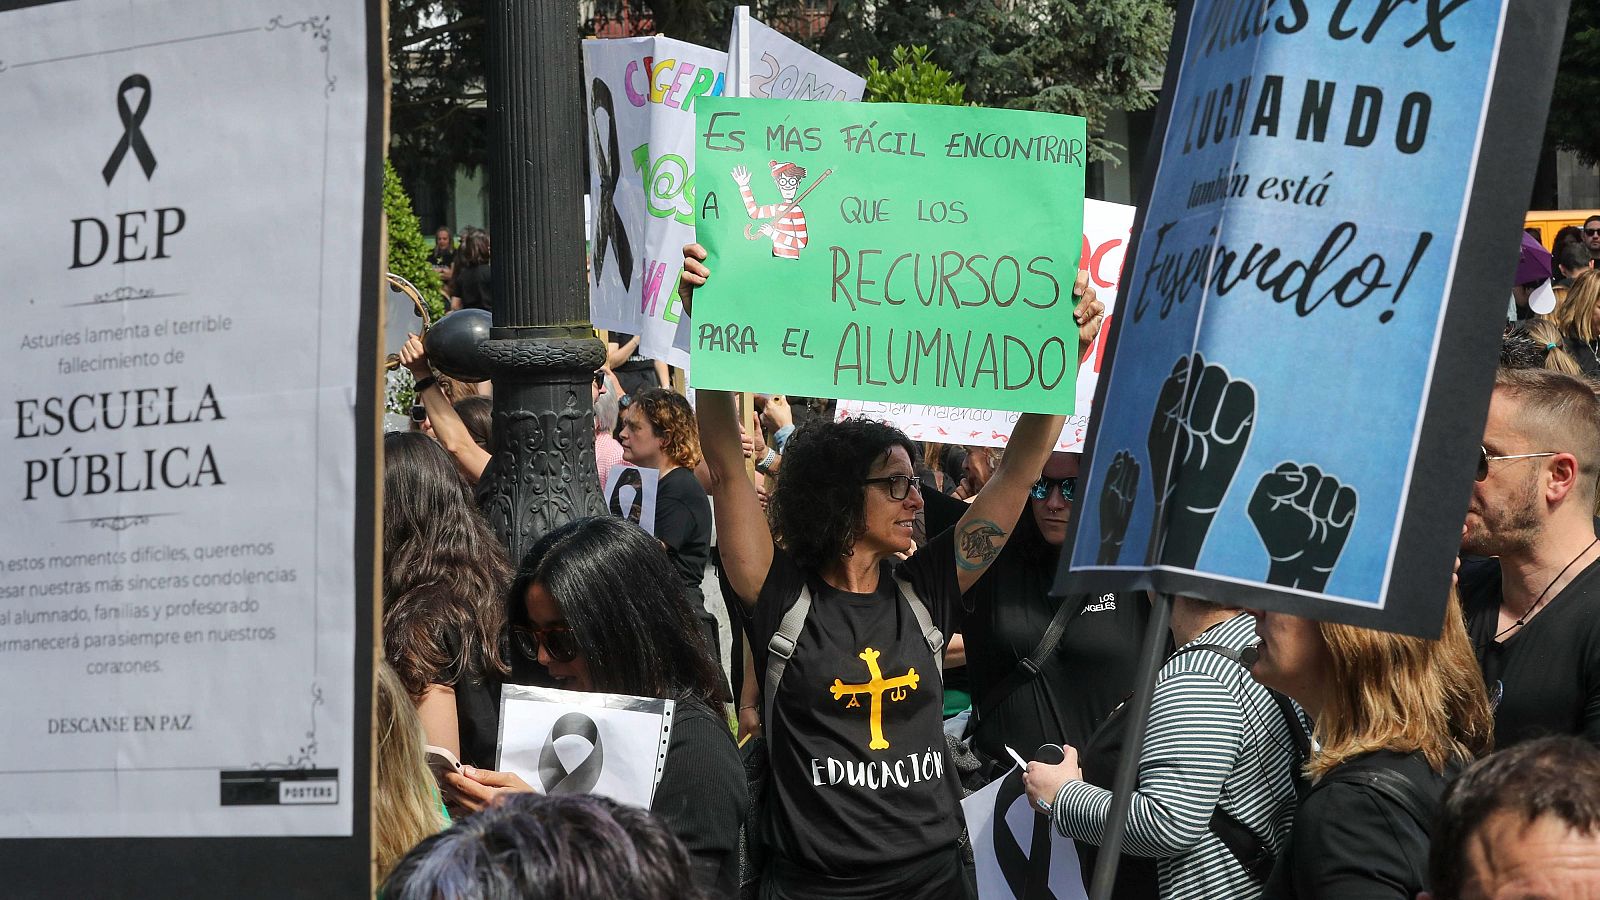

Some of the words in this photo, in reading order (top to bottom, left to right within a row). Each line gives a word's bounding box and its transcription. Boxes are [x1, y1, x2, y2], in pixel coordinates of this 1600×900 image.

[1183, 75, 1432, 154] LUCHANDO
[766, 114, 822, 153] MÁS
[840, 120, 926, 157] FÁCIL
[945, 132, 1083, 168] ENCONTRAR
[1257, 170, 1333, 207] está
[702, 192, 720, 220] A
[840, 196, 891, 224] QUE
[918, 199, 969, 224] LOS
[68, 207, 187, 270] DEP
[829, 245, 1060, 311] RECURSOS
[20, 331, 81, 350] Asturies
[84, 325, 150, 344] lamenta
[154, 319, 169, 337] el
[173, 314, 233, 334] terrible
[58, 352, 160, 375] fallecimiento
[163, 348, 186, 365] de
[698, 323, 759, 354] PARA
[782, 328, 814, 358] EL
[834, 321, 1066, 391] ALUMNADO
[15, 383, 227, 439] ESCUELA
[22, 444, 227, 501] PÚBLICA
[7, 556, 46, 572] estos
[49, 550, 127, 568] momentos
[193, 541, 275, 562] queremos
[29, 579, 91, 597] nuestras
[95, 575, 124, 592] más
[128, 574, 189, 591] sinceras
[192, 566, 297, 587] condolencias
[1099, 592, 1115, 603] LOS
[14, 606, 91, 626] alumnado,
[94, 603, 149, 620] familias
[152, 604, 162, 622] y
[165, 596, 260, 618] profesorado
[0, 632, 80, 651] rmanecerá
[183, 629, 204, 644] en
[208, 626, 277, 642] nuestros
[86, 659, 162, 675] corazones.
[48, 716, 129, 734] DESCANSE
[133, 715, 155, 732] EN
[160, 714, 192, 731] PAZ
[811, 746, 944, 790] EDUCACIÓN
[285, 787, 332, 798] POSTERS
